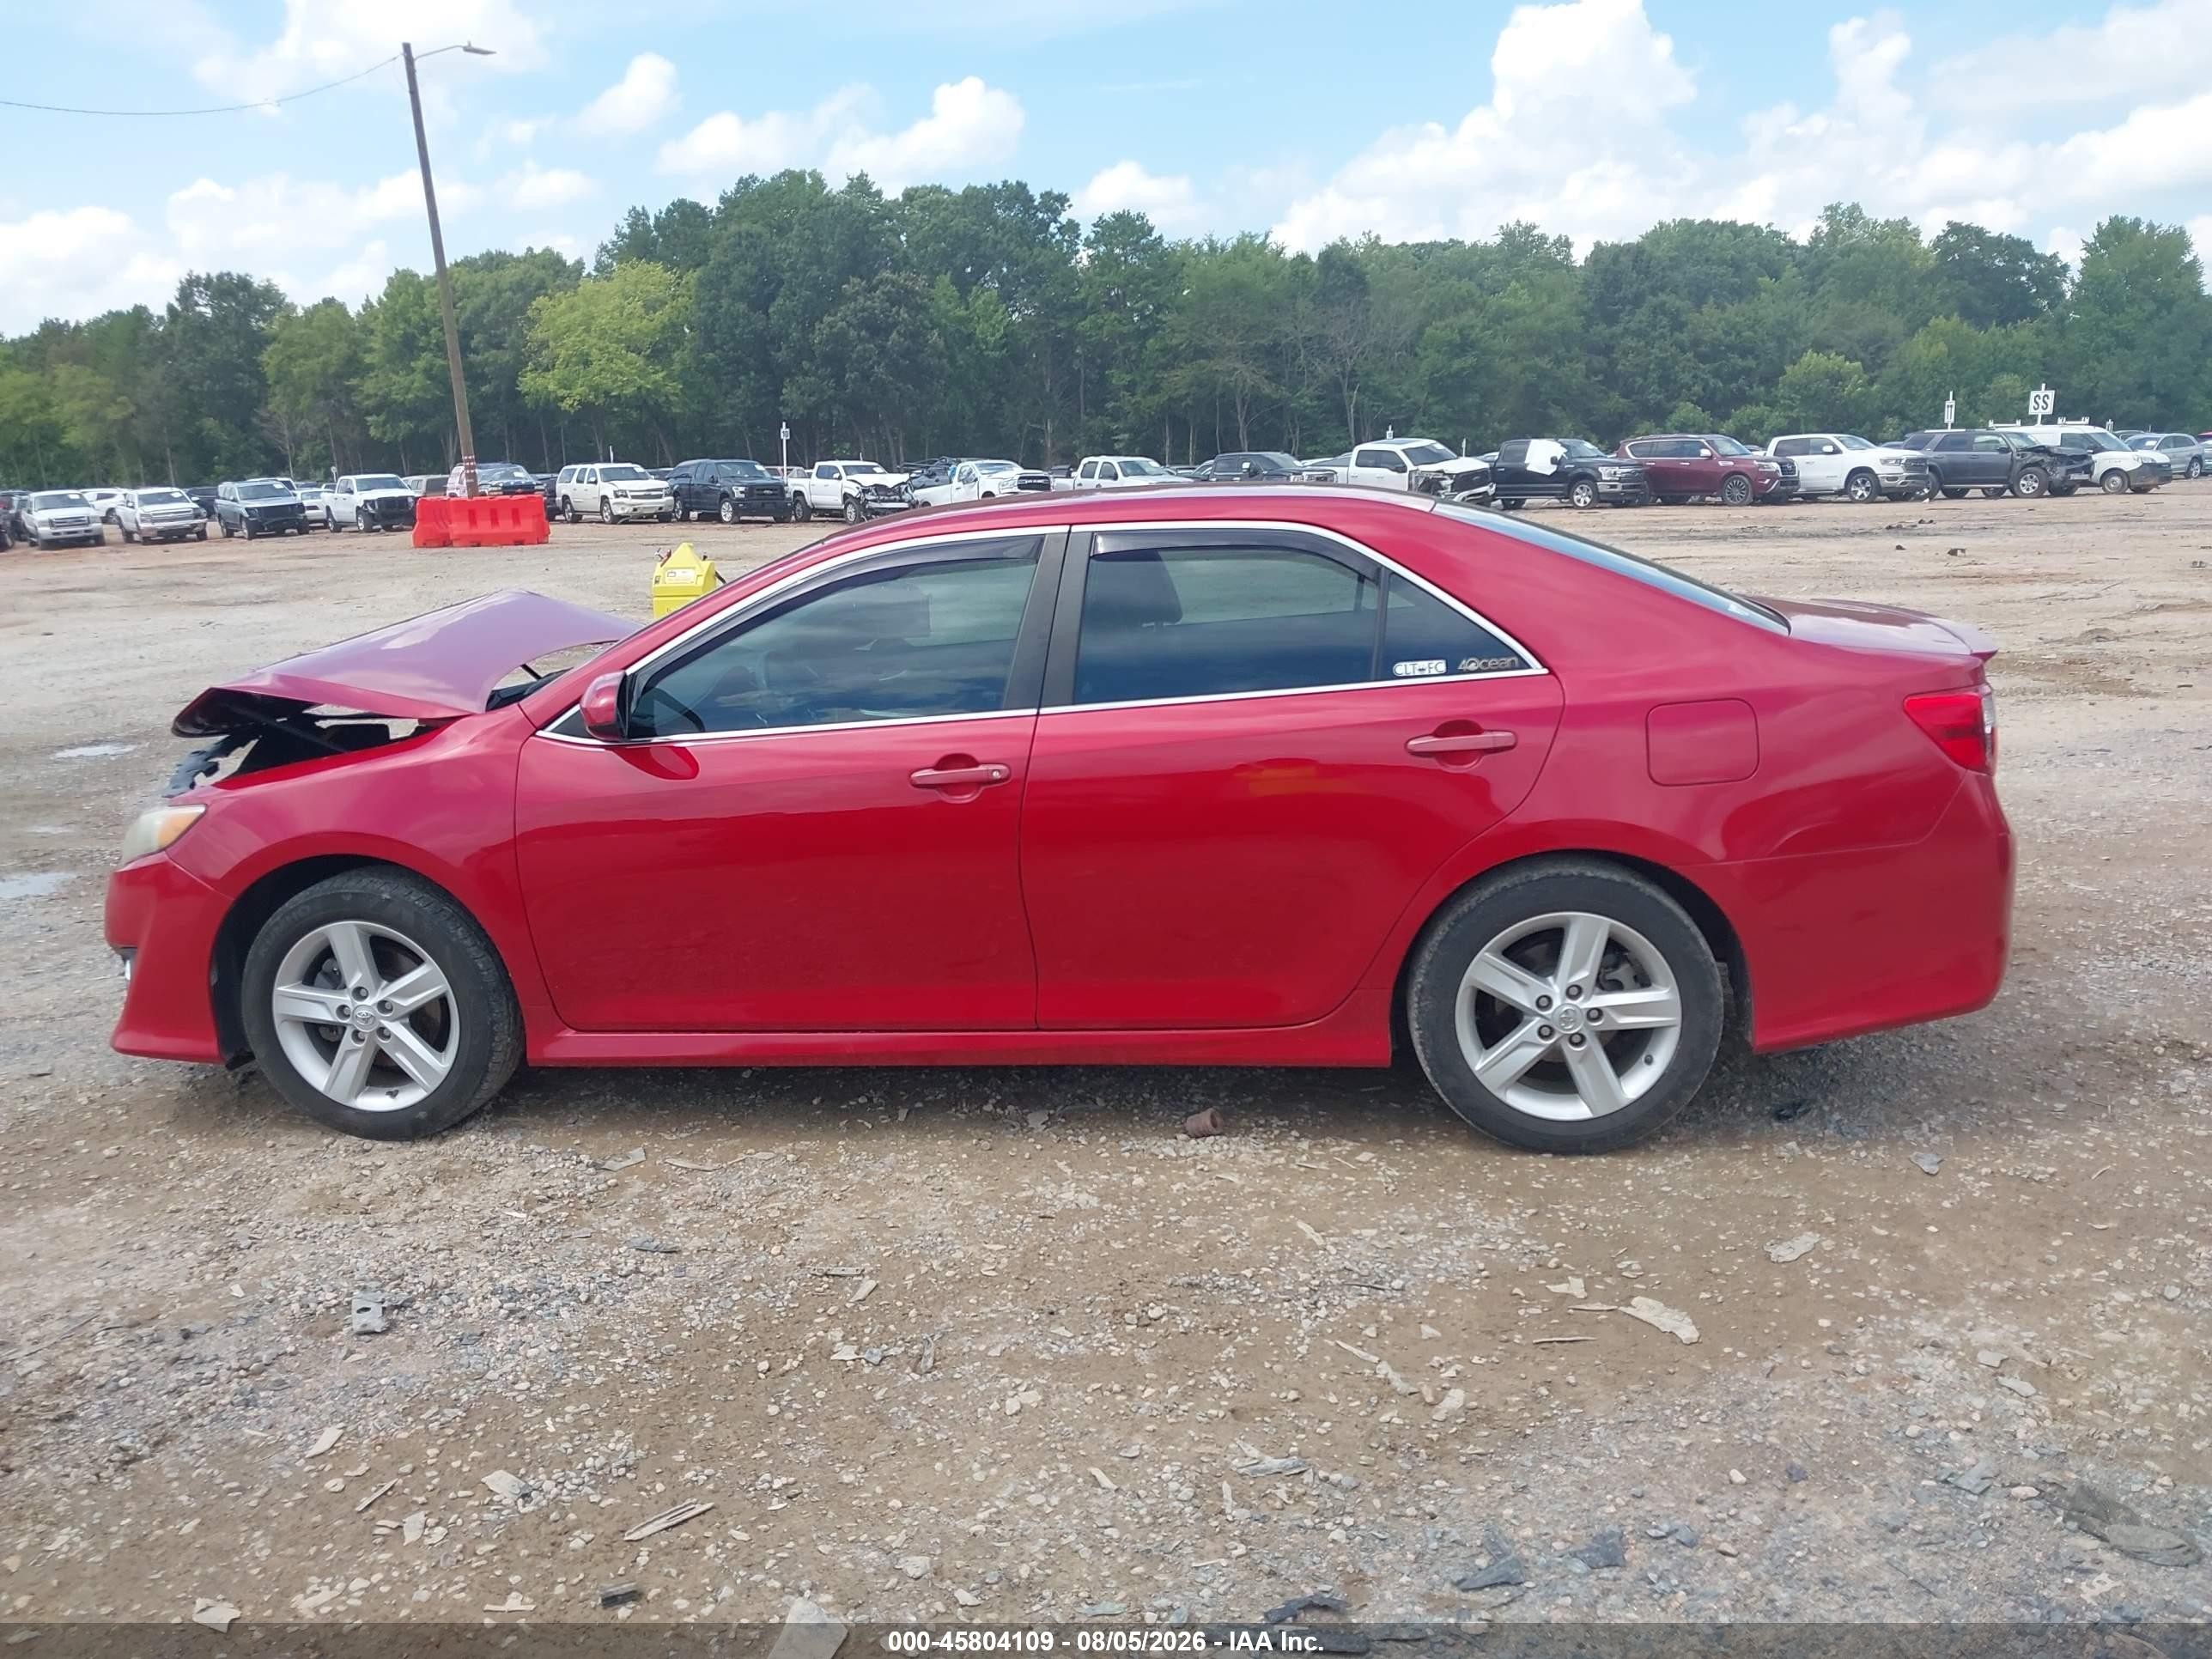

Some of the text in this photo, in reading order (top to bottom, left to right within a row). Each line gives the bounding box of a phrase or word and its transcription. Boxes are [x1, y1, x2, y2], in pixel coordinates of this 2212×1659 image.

[2033, 394, 2050, 410] SS
[1394, 661, 1444, 676] CLT FC
